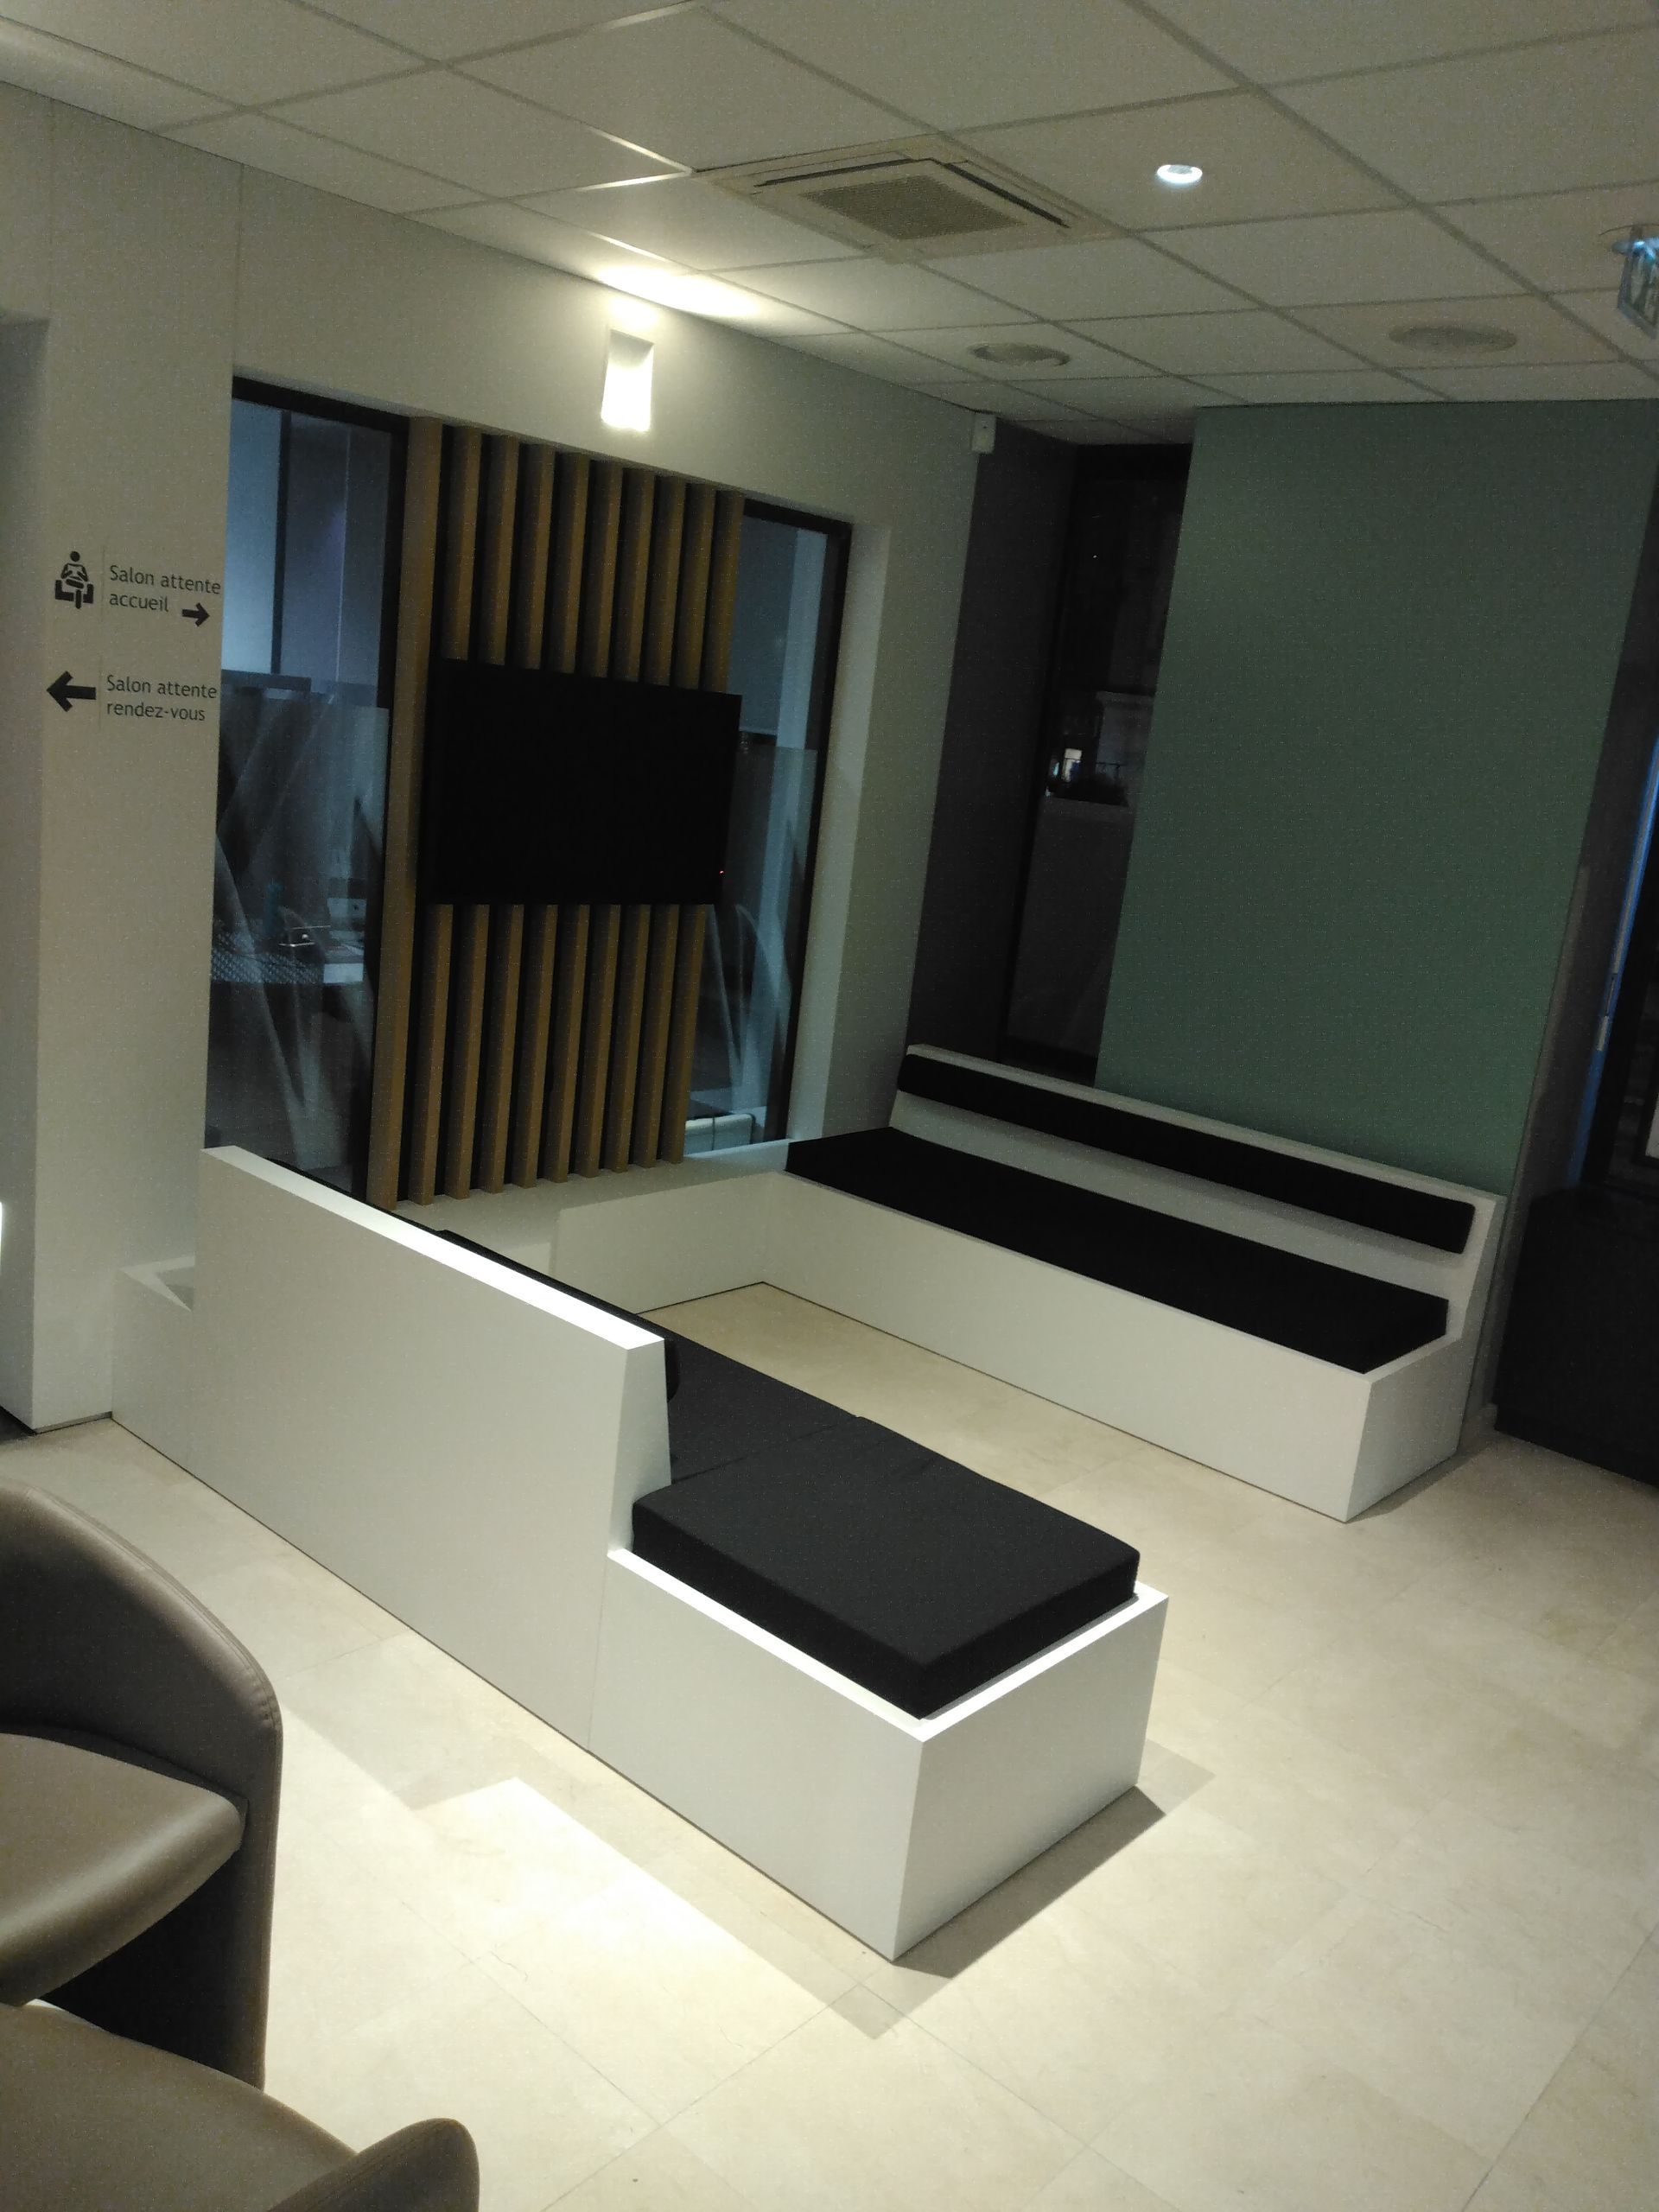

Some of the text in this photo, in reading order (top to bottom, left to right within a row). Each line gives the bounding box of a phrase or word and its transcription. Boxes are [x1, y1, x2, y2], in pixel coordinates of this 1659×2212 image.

[110, 565, 221, 594] Salon attente
[109, 593, 168, 613] accueil
[106, 675, 218, 699] Salon attente
[106, 701, 206, 721] rendez-vous
